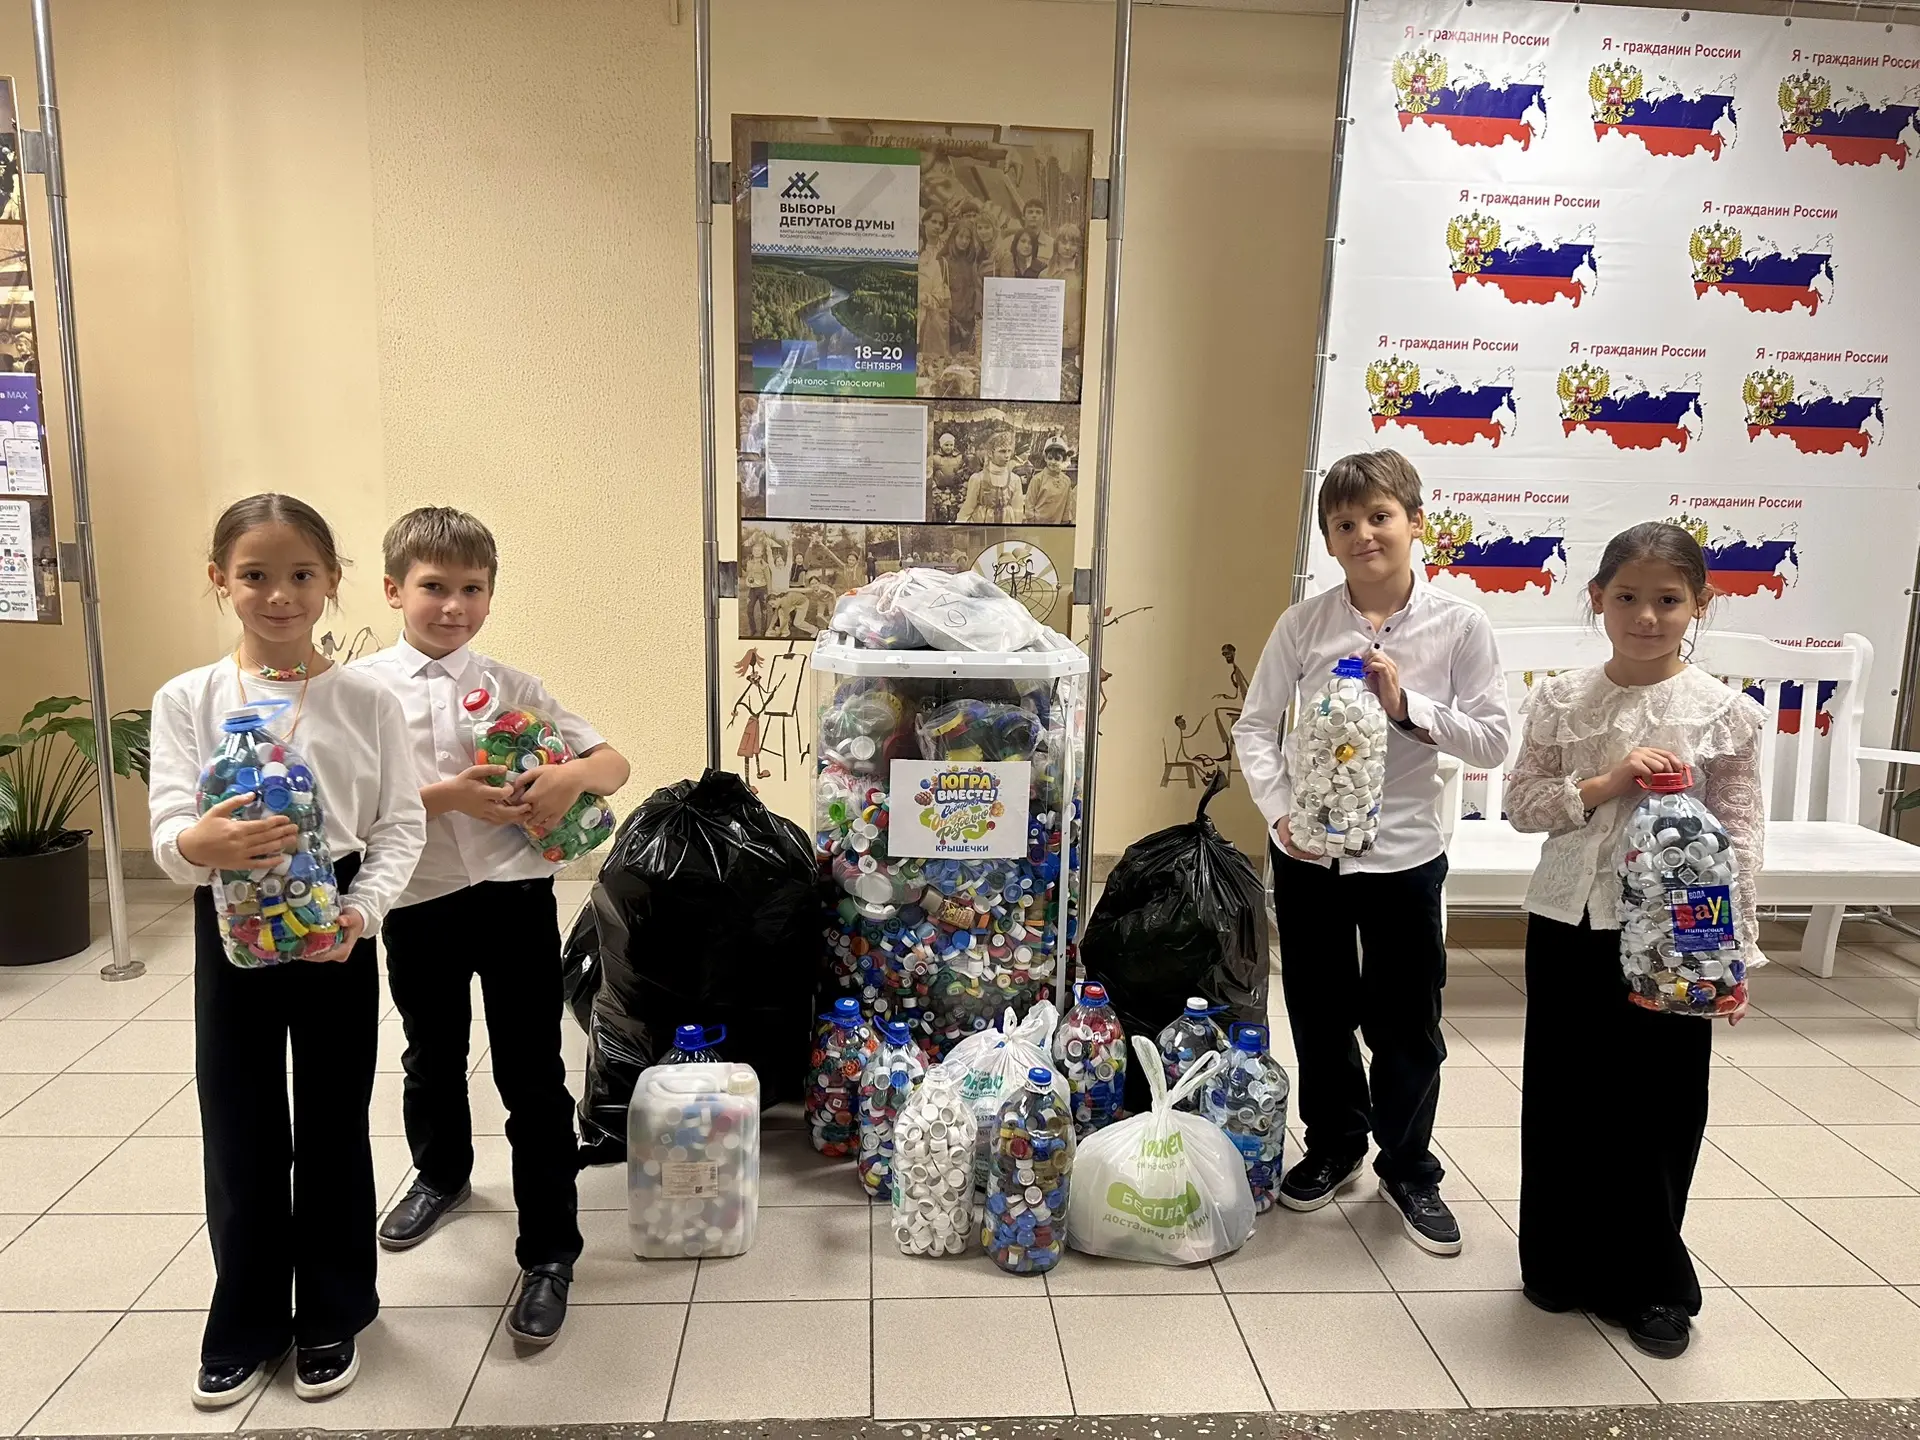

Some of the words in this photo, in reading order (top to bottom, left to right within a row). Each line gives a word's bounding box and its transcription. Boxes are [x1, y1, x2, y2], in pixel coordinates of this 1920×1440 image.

[1404, 26, 1414, 39] Я
[1428, 29, 1498, 43] гражданин
[1502, 31, 1550, 46] России
[1602, 38, 1612, 50] Я
[1623, 42, 1691, 56] гражданин
[1694, 44, 1741, 58] России
[1791, 49, 1801, 61] Я
[1812, 53, 1879, 67] гражданин
[1459, 190, 1469, 202] Я
[1481, 193, 1550, 207] гражданин
[1554, 194, 1600, 208] России
[780, 203, 836, 215] ВЫБОРЫ
[1702, 201, 1712, 213] Я
[1723, 205, 1790, 218] гражданин
[1793, 205, 1838, 219] России
[779, 216, 853, 229] ДЕПУТАТОВ
[854, 219, 895, 231] ДУМЫ
[875, 331, 902, 343] 2026
[1378, 335, 1388, 347] Я
[1400, 338, 1469, 351] гражданин
[1473, 338, 1518, 351] России
[1569, 342, 1579, 353] Я
[1590, 345, 1658, 357] гражданин
[1661, 345, 1706, 357] России
[1756, 348, 1765, 359] Я
[1776, 351, 1841, 363] гражданин
[1845, 351, 1888, 363] России
[854, 362, 902, 371] СЕНТЯБРЯ
[804, 378, 828, 387] ГОЛОС
[836, 379, 860, 388] ГОЛОС
[861, 380, 885, 389] ЮГРЫ!
[7, 391, 28, 399] MAX
[1432, 489, 1442, 501] Я
[1453, 492, 1520, 505] гражданин
[1524, 491, 1569, 503] России
[1669, 494, 1679, 506] Я
[1689, 497, 1755, 509] гражданин
[1758, 496, 1802, 508] России
[1805, 637, 1843, 647] Росси
[941, 774, 991, 789] ЮГРА
[937, 789, 995, 801] ВМЕСТЕ!
[1688, 890, 1706, 899] ВОДА
[1122, 1192, 1186, 1220] БЕСПЛА
